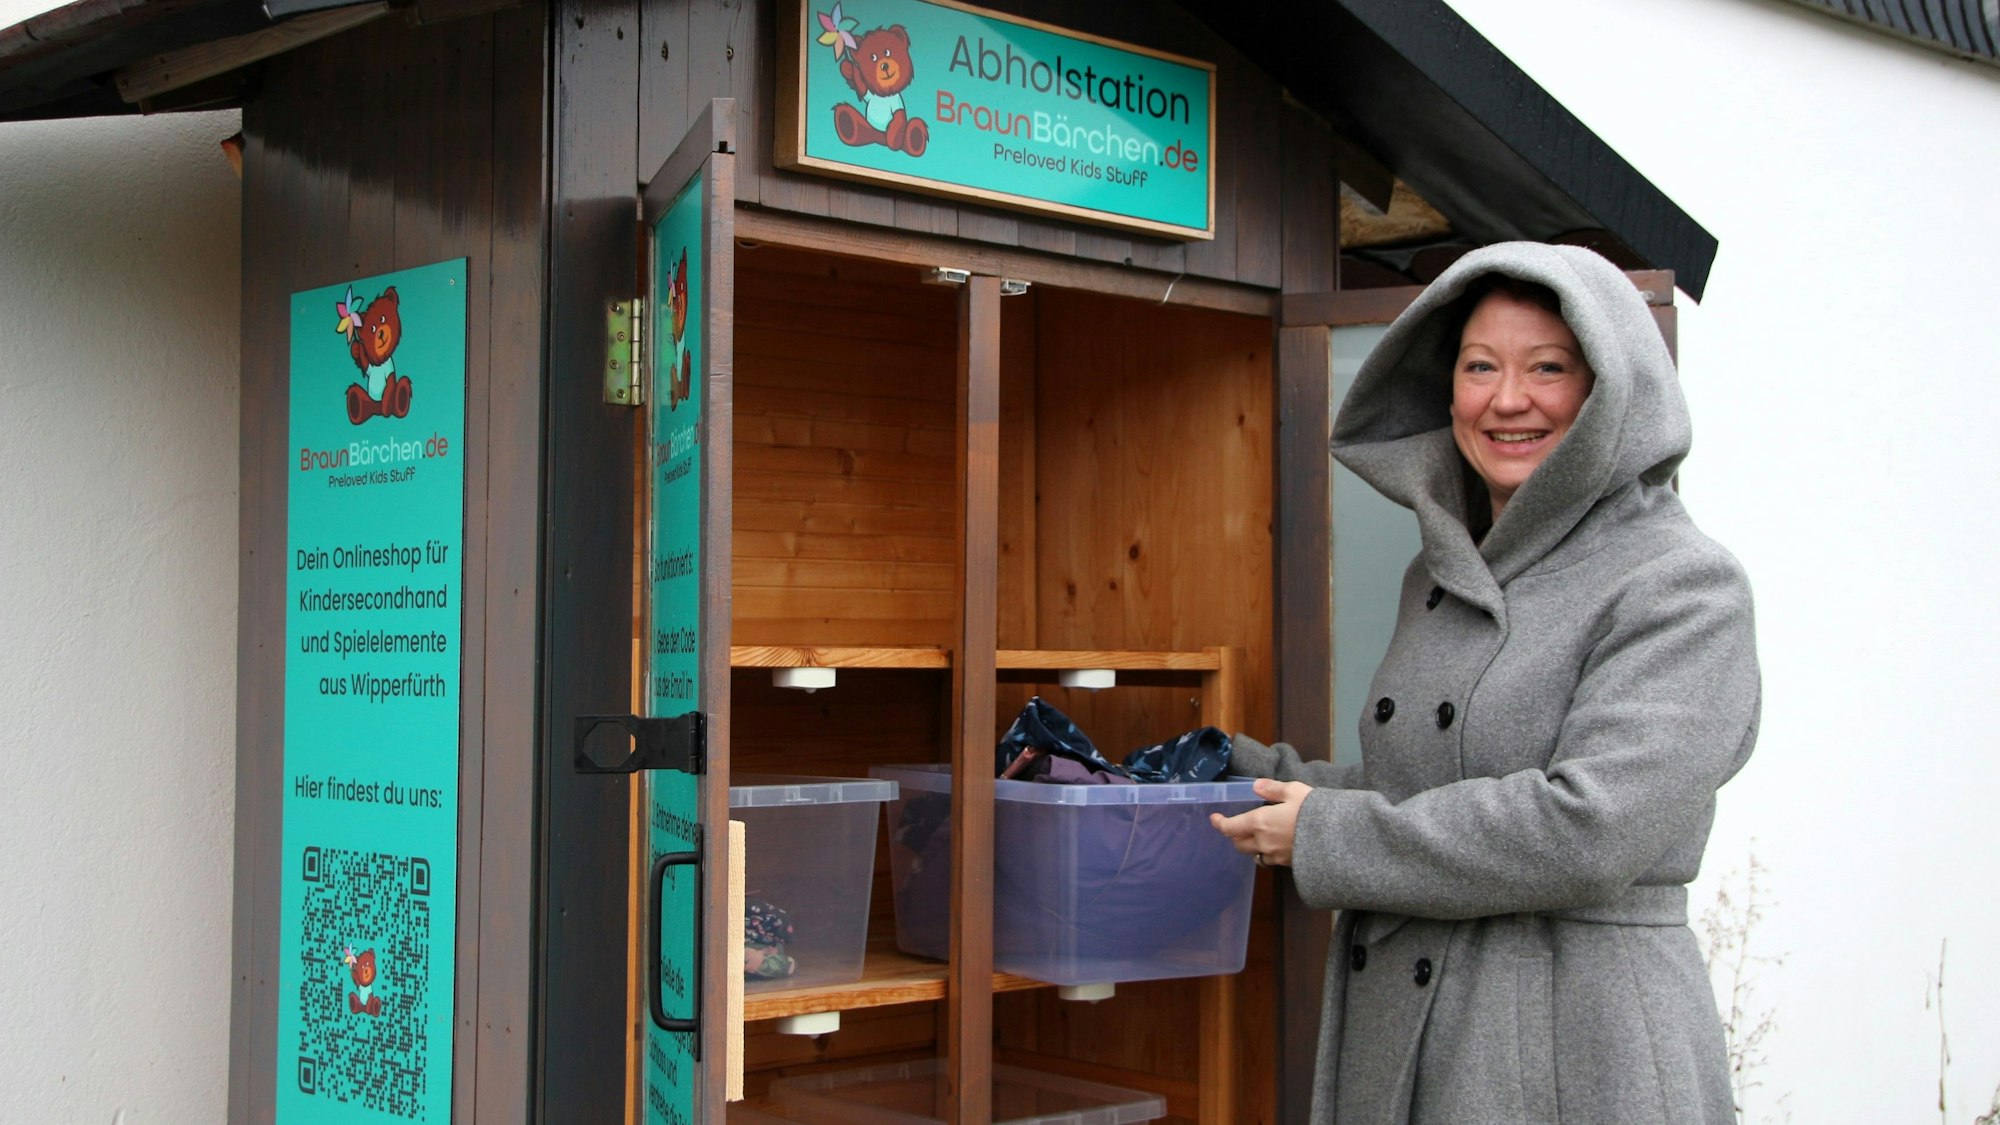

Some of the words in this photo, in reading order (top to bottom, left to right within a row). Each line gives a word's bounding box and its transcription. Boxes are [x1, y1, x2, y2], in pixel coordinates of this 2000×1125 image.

[949, 35, 1190, 125] Abholstation
[936, 90, 1199, 173] BraunBärchen.de
[994, 144, 1066, 172] Preloved
[1070, 160, 1102, 180] Kids
[1106, 167, 1149, 188] Stuff
[300, 432, 448, 472] BraunBärchen.de
[328, 471, 368, 488] Preloved
[369, 470, 388, 485] Kids
[390, 467, 416, 483] Stuff
[297, 547, 328, 570] Dein
[333, 543, 421, 573] Onlineshop
[426, 540, 449, 565] für
[300, 584, 447, 612] Kindersecondhand
[301, 630, 329, 653] und
[334, 630, 447, 660] Spielelemente
[681, 625, 696, 653] Code
[319, 674, 346, 695] aus
[351, 672, 446, 703] Wipperfürth
[295, 776, 323, 799] Hier
[327, 777, 379, 802] findest
[383, 781, 404, 805] du
[409, 787, 442, 808] uns:
